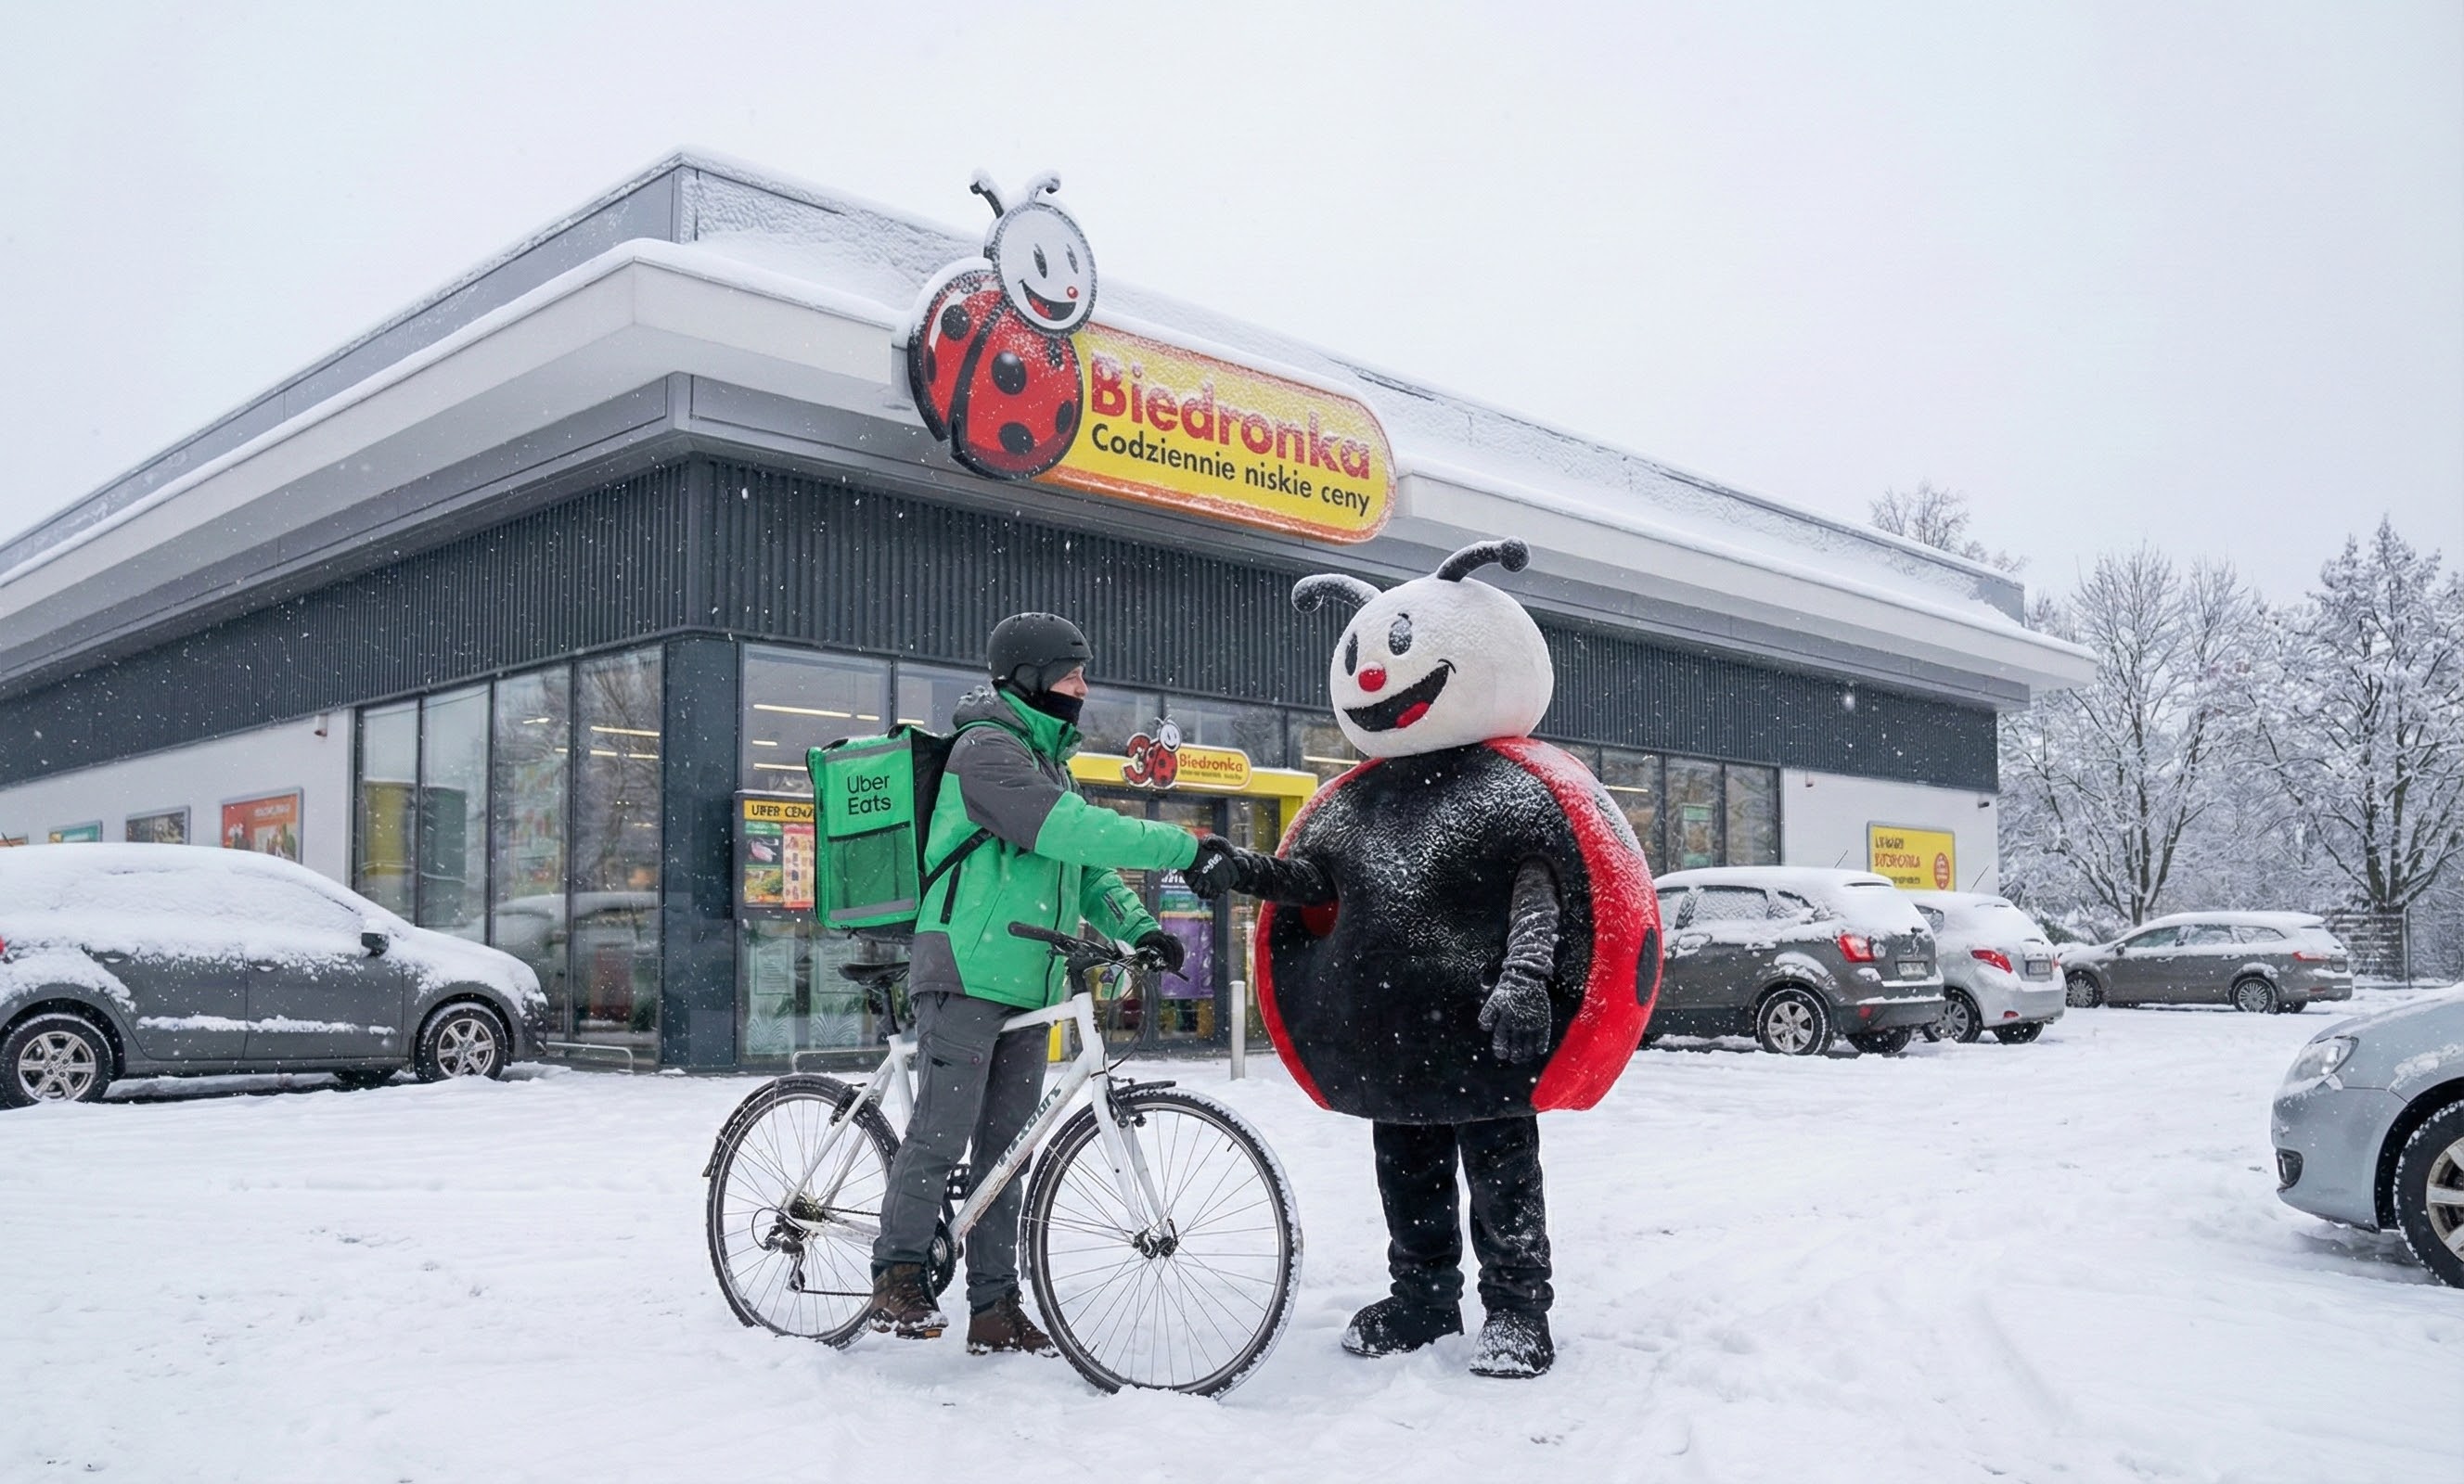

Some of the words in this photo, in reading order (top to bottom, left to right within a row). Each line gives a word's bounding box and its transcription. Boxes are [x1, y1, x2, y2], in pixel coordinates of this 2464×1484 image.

[1091, 351, 1370, 480] Biedronka
[1091, 422, 1236, 480] Codziennie
[1245, 461, 1312, 499] niskie
[1321, 485, 1370, 518] ceny
[847, 774, 891, 794] Uber
[848, 795, 892, 815] Eats
